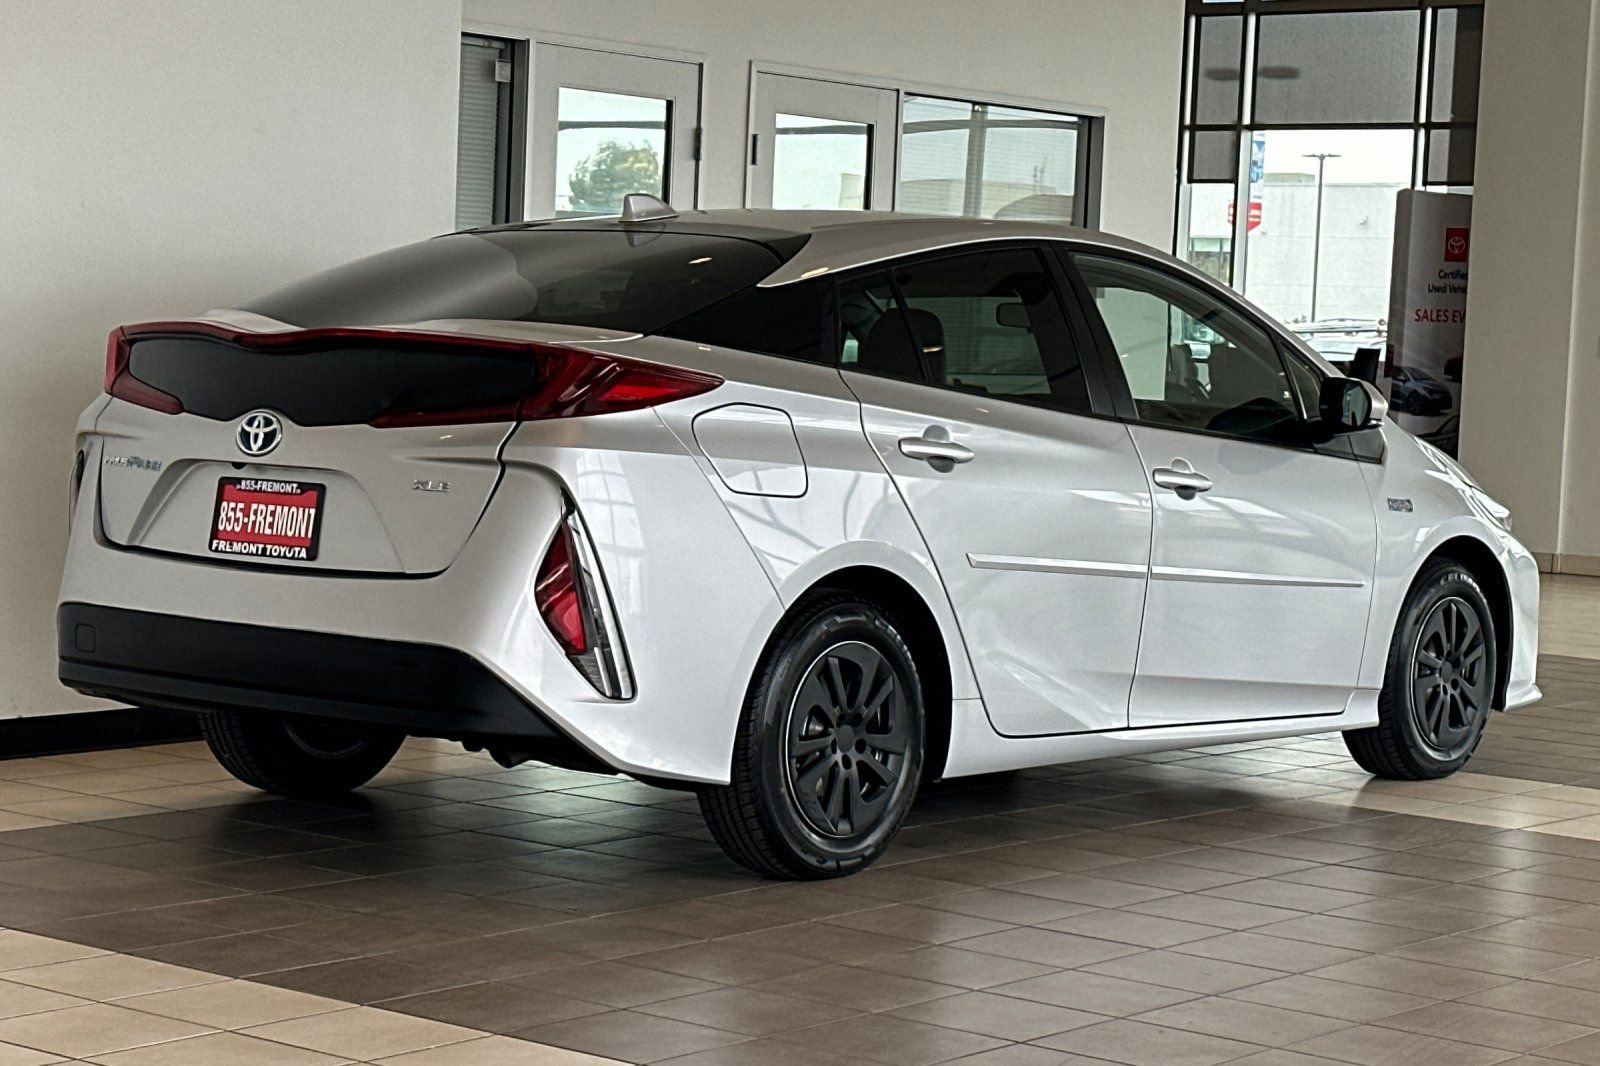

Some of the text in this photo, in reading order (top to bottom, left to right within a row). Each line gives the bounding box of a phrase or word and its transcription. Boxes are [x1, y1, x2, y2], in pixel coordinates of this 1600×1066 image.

[1428, 283, 1447, 293] Used
[1414, 308, 1449, 323] SALES
[240, 479, 298, 494] 855-FREMONT
[217, 500, 316, 539] 855-FREMONT
[211, 539, 307, 559] FREMONT TOYOTA
